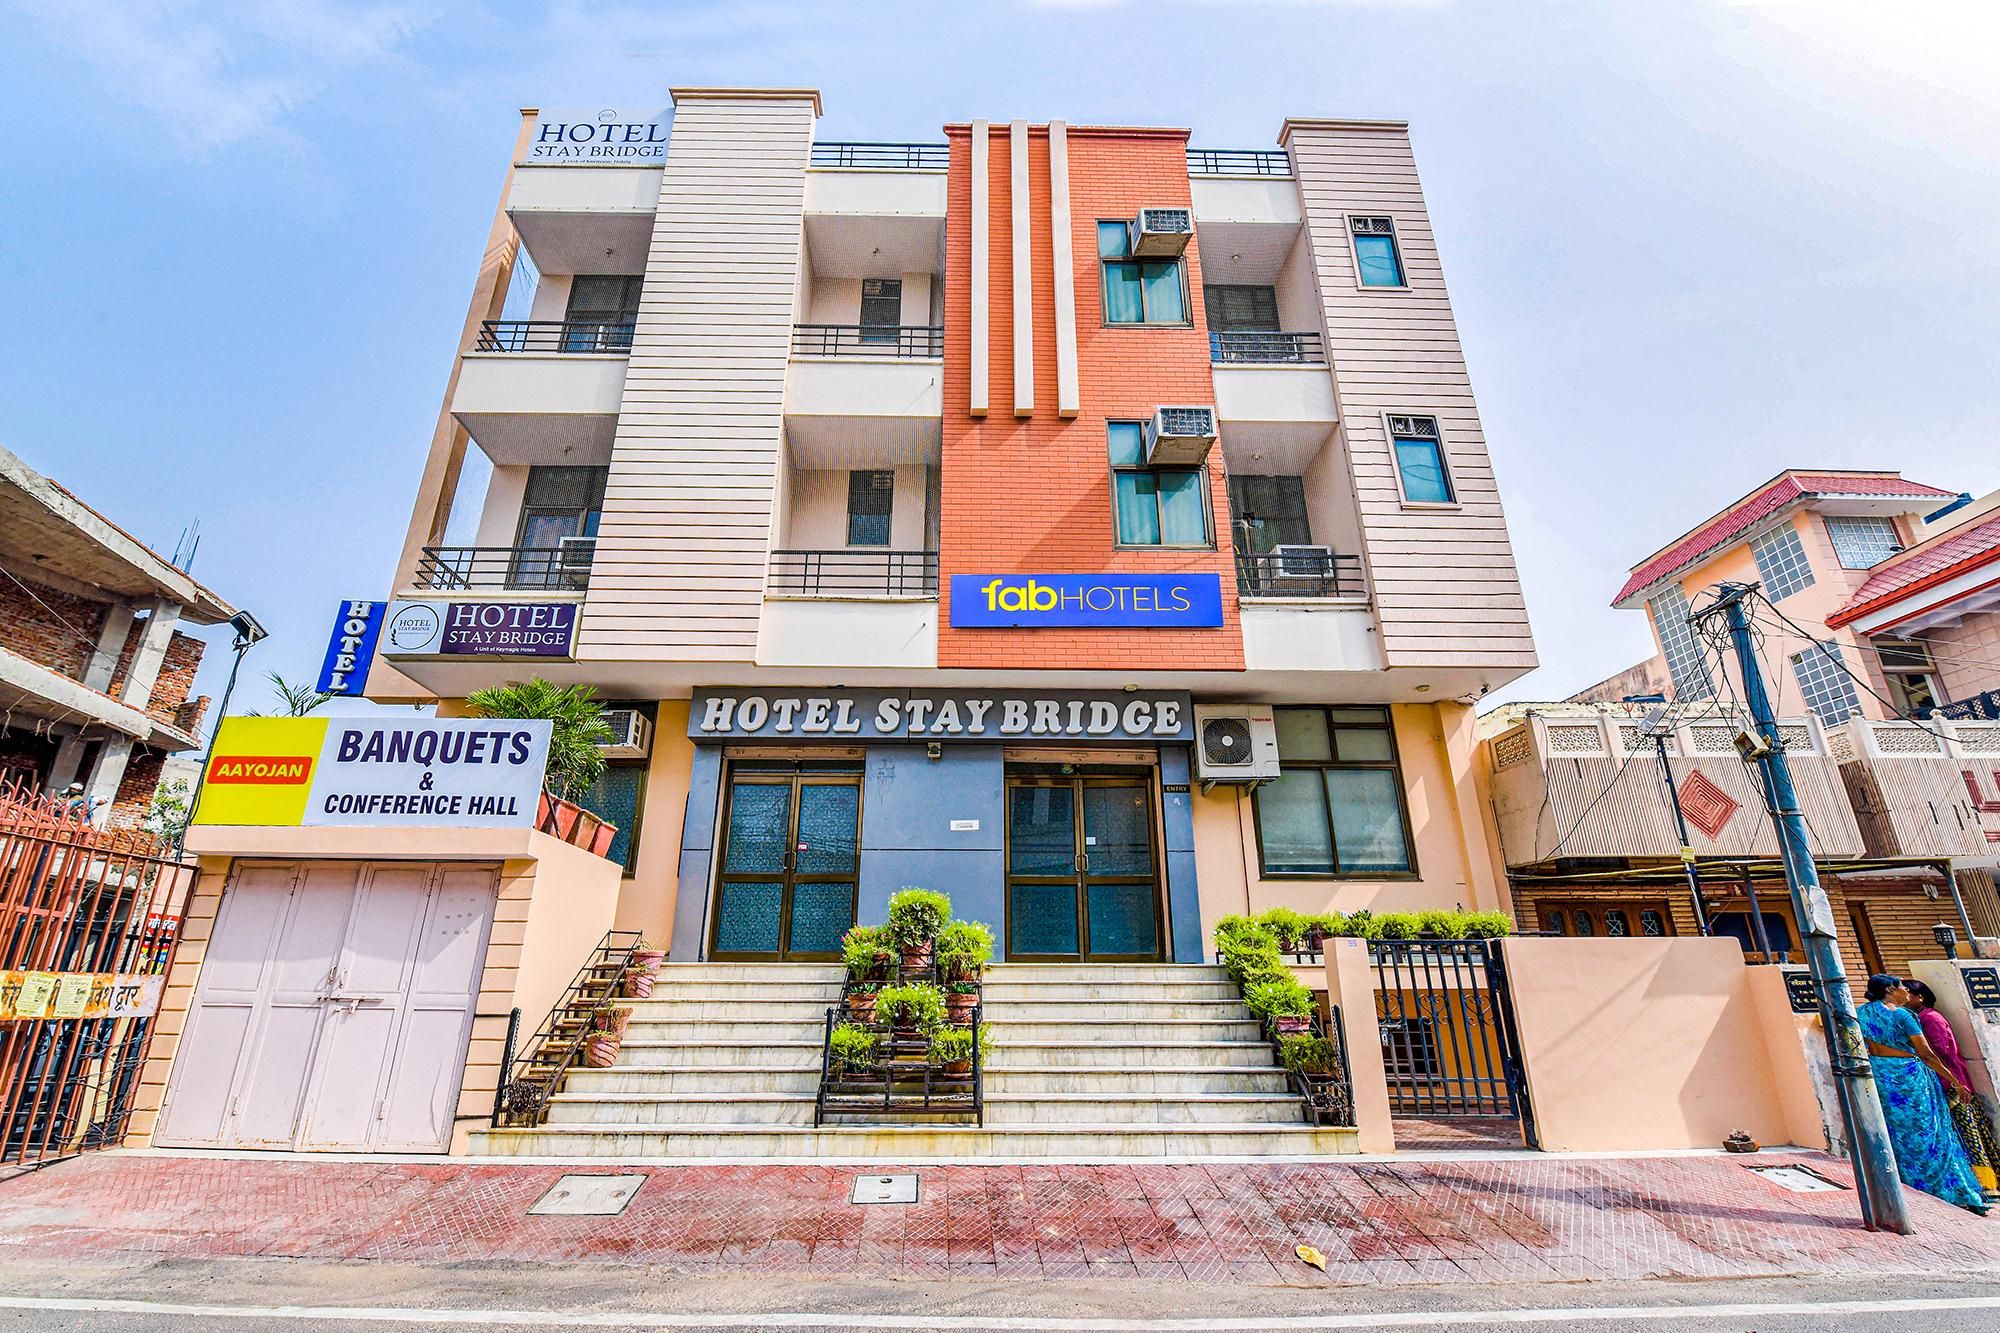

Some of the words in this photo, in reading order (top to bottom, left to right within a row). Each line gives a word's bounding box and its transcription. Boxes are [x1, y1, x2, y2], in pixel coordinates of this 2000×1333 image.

[537, 123, 667, 143] HOTEL
[533, 145, 586, 157] STAY
[588, 145, 664, 157] BRIDGE
[399, 619, 431, 627] HOTEL
[452, 605, 569, 629] HOTEL
[328, 601, 372, 691] HOTEL
[449, 631, 495, 645] STAY
[500, 632, 565, 646] BRIDGE
[700, 697, 861, 733] HOTEL
[875, 698, 995, 734] STAY
[1000, 699, 1183, 735] BRIDGE
[336, 730, 532, 767] BANQUETS
[216, 763, 304, 778] AAYOJAN
[418, 771, 434, 791] &
[323, 794, 461, 814] CONFERENCE
[467, 796, 519, 816] HALL
